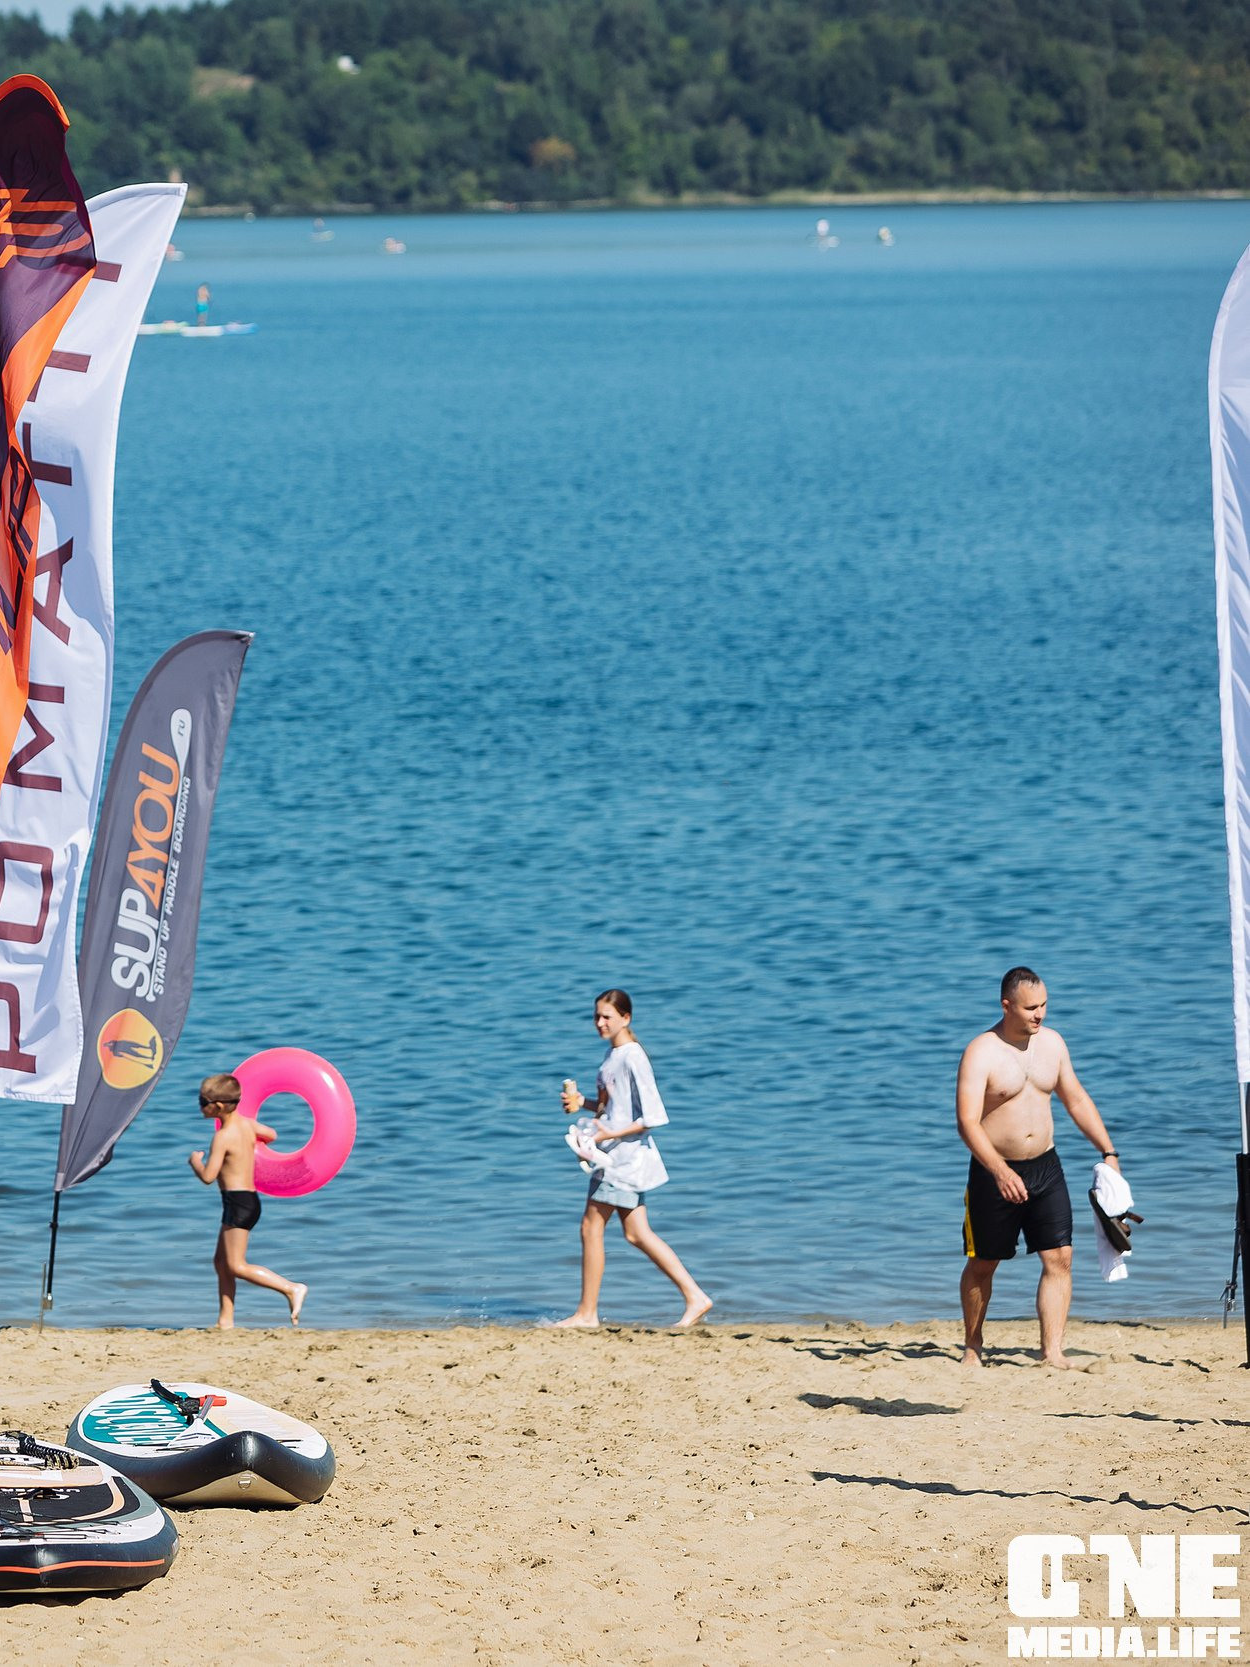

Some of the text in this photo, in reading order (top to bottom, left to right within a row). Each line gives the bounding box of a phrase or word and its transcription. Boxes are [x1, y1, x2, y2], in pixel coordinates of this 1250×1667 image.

[110, 741, 180, 998] SUP4YOU
[153, 776, 191, 995] STAND UP PADDLE BOARDING
